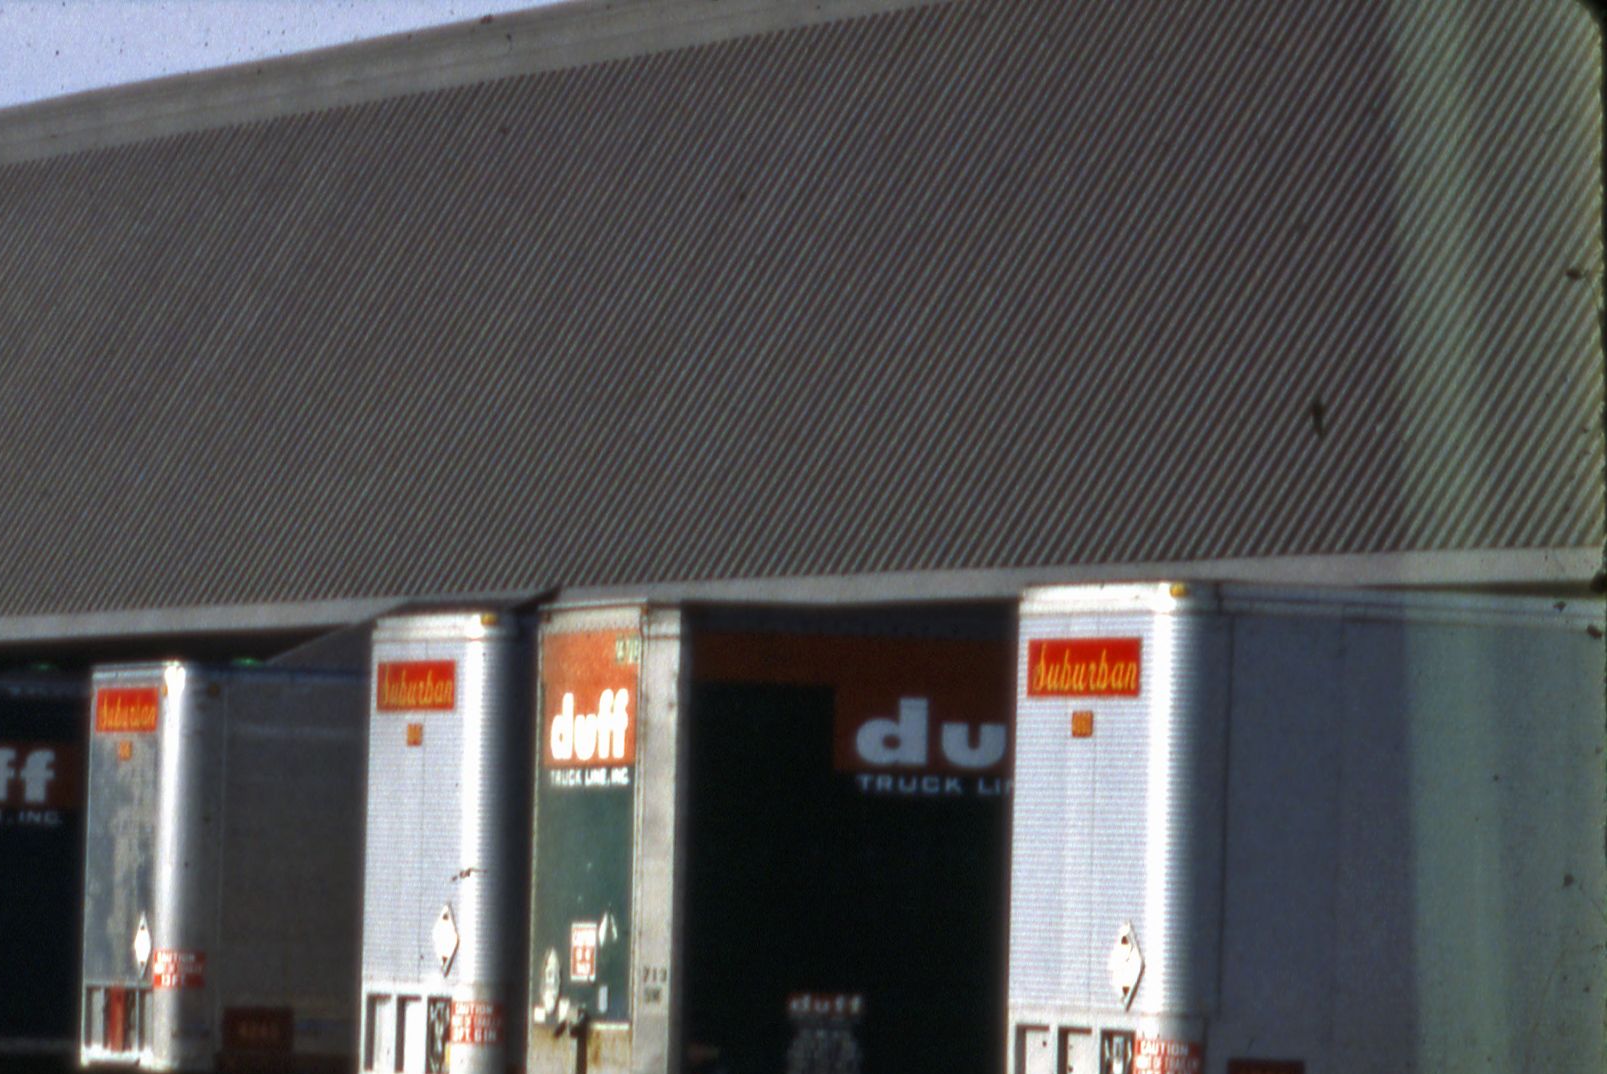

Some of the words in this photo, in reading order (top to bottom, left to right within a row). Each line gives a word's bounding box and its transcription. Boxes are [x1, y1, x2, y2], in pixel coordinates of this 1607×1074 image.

[1032, 642, 1138, 692] Suburban
[551, 688, 629, 760] duff
[856, 774, 963, 793] TRUCK
[1141, 1041, 1189, 1056] CAUTION
